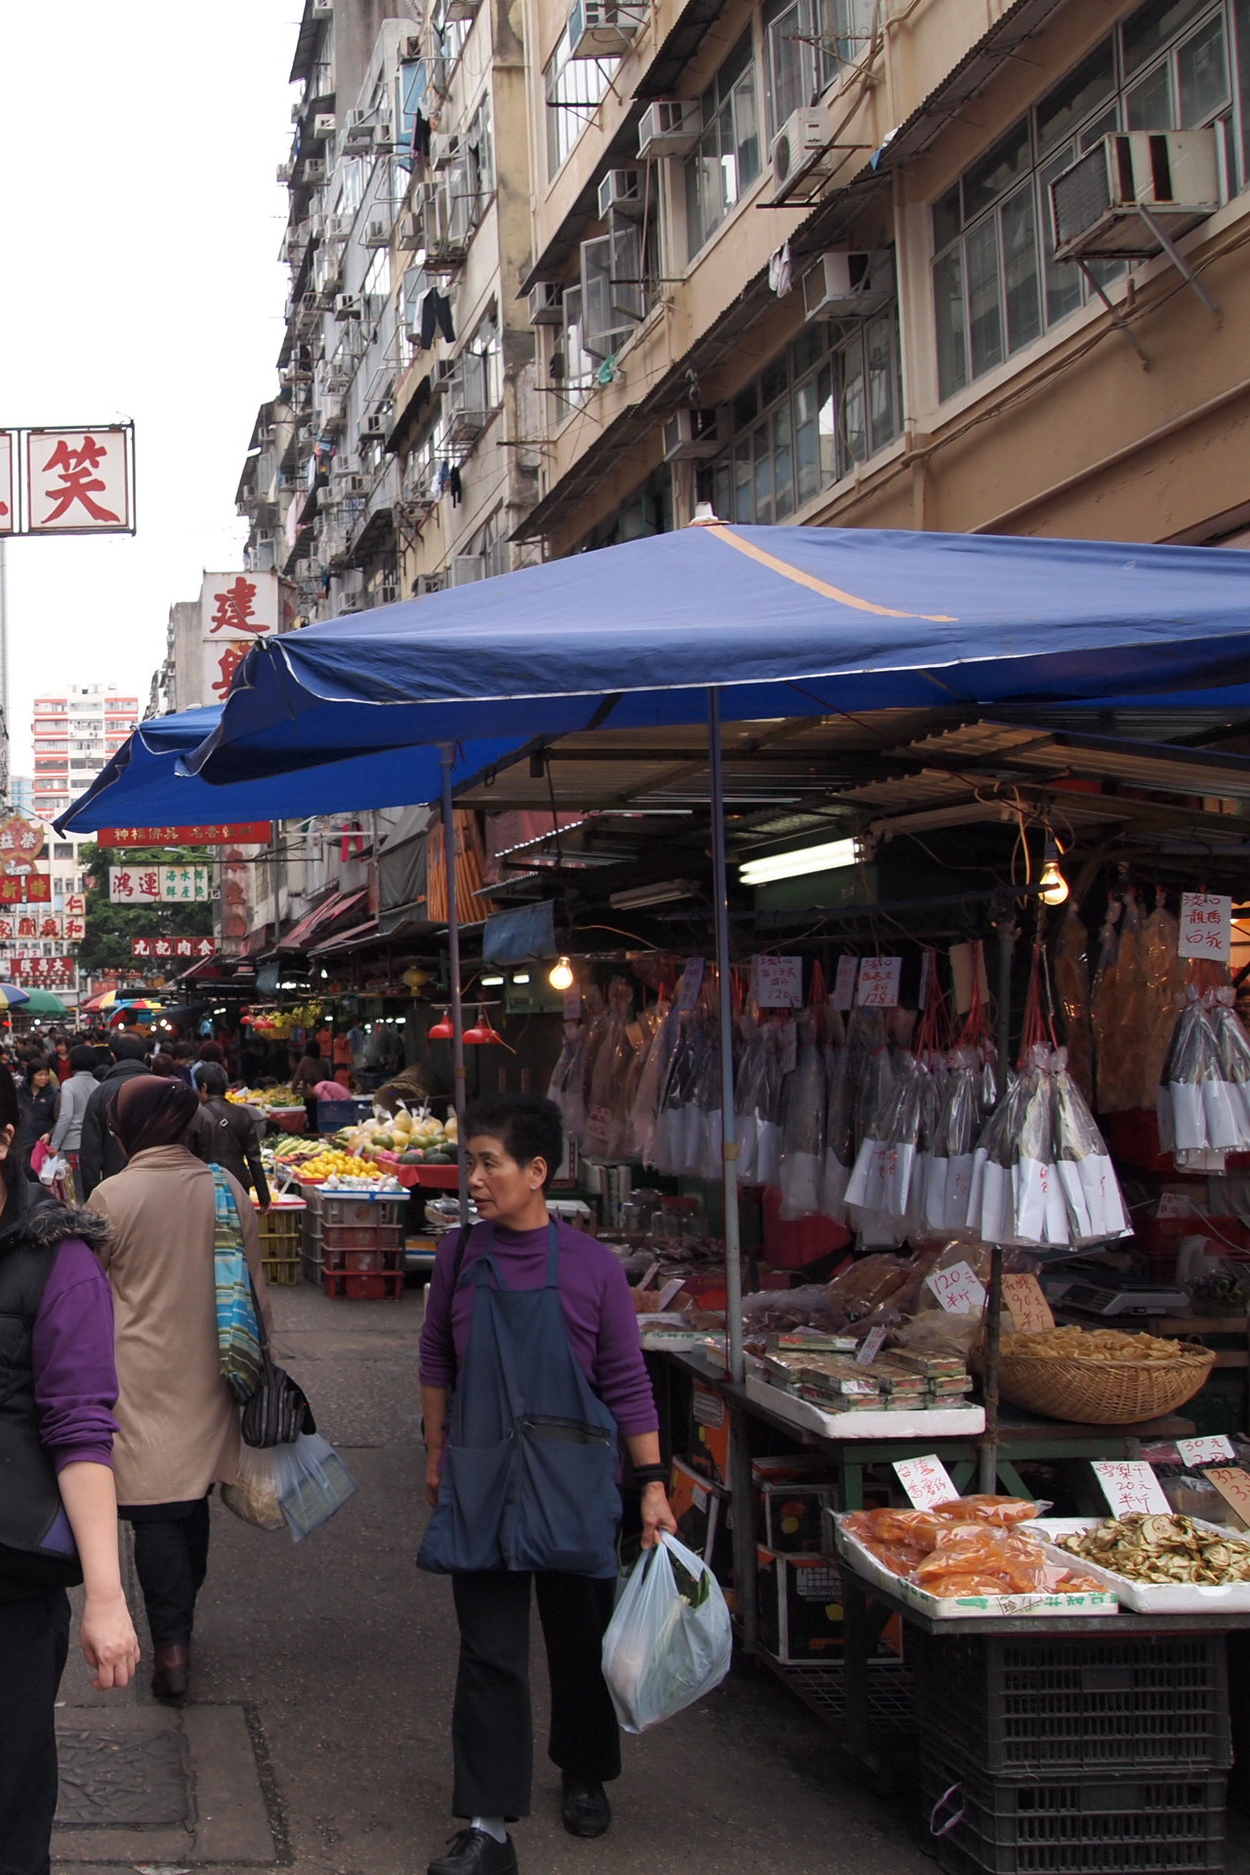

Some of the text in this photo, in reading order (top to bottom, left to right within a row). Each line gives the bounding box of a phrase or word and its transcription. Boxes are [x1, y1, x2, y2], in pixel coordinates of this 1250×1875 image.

[113, 871, 160, 897] 鴻運
[134, 939, 214, 956] 九記肉食
[934, 1270, 975, 1296] 120元
[1182, 1437, 1225, 1452] 30元
[1116, 1480, 1152, 1491] 20元
